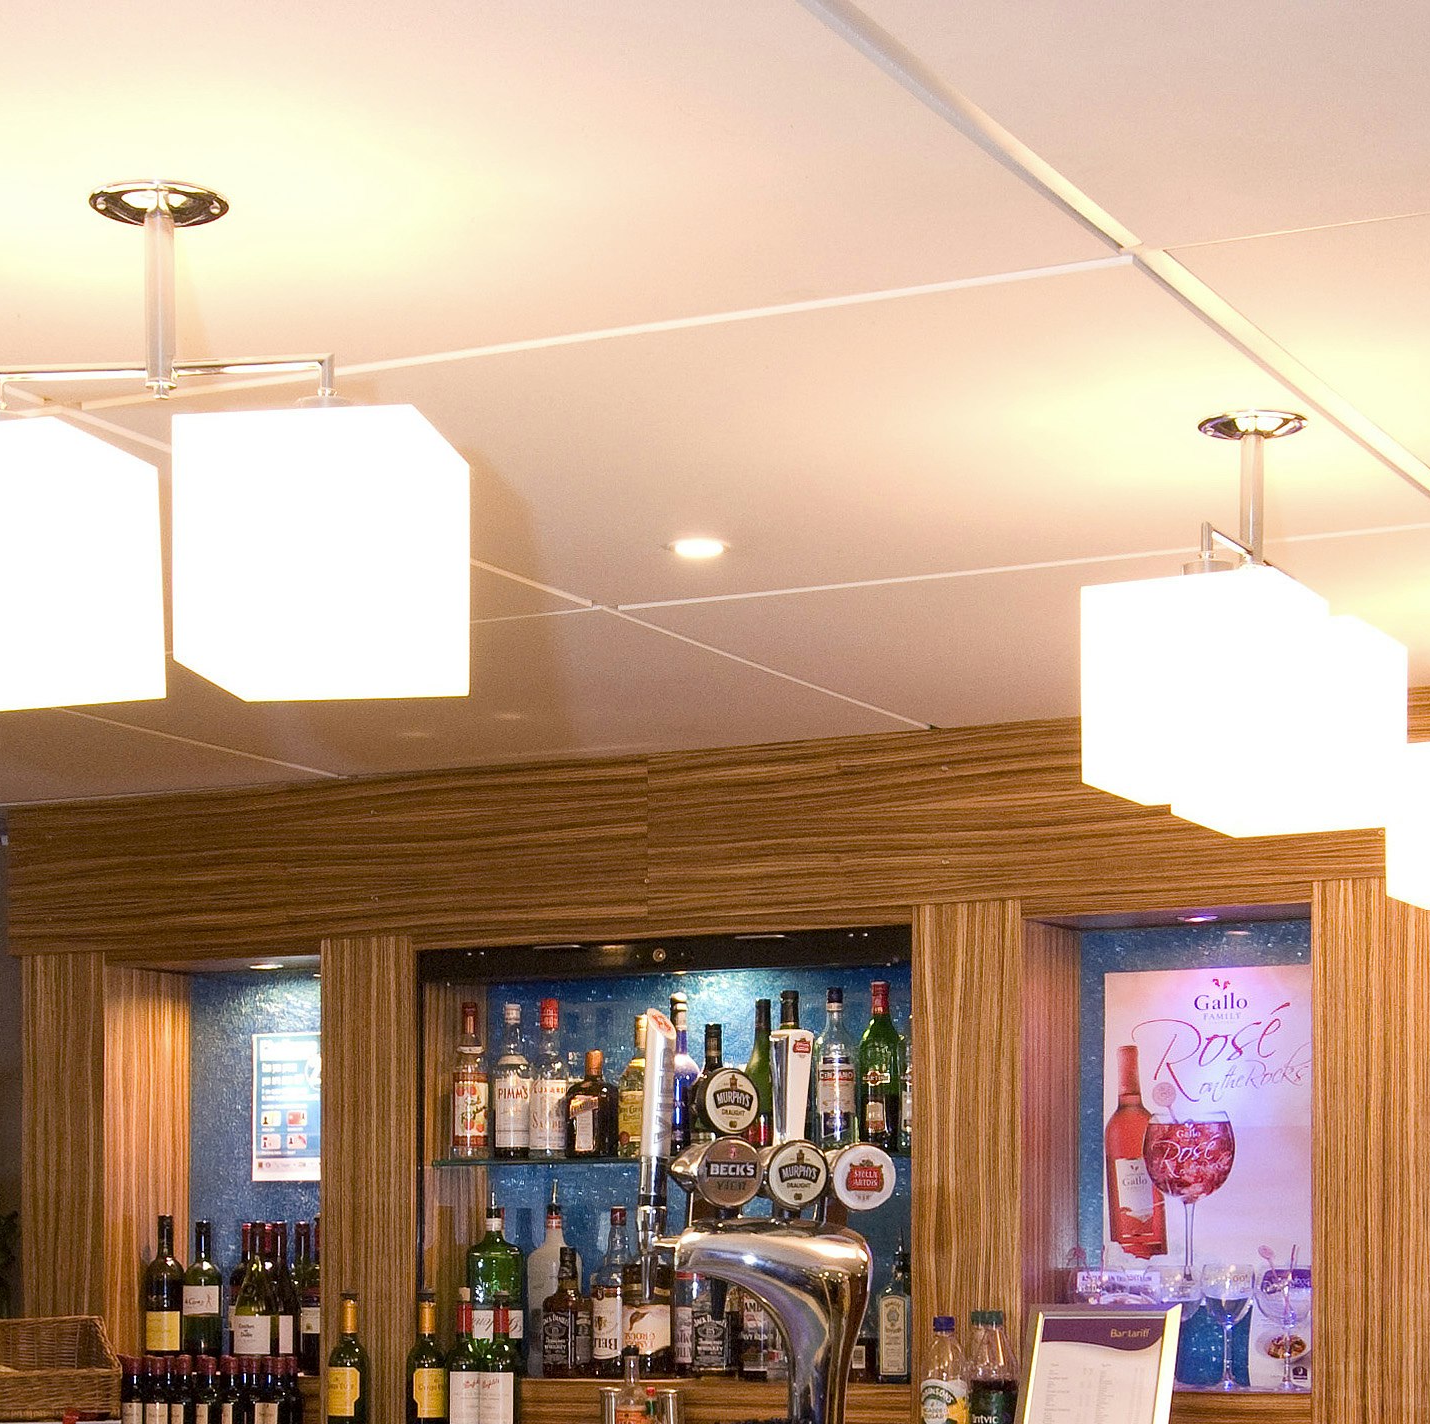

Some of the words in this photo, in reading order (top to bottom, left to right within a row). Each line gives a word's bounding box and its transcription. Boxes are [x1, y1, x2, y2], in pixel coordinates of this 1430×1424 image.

[1193, 992, 1248, 1011] Gallo
[1131, 1002, 1291, 1103] Rosé
[498, 1085, 529, 1099] PIMM'S
[1176, 1128, 1202, 1138] Gallo
[709, 1162, 755, 1177] BECK'S
[854, 1170, 878, 1179] STELLA
[716, 1180, 747, 1191] VIER
[852, 1179, 878, 1187] ARTOIS
[1122, 1175, 1148, 1187] Gallo
[1110, 1328, 1126, 1338] Bar
[1127, 1327, 1151, 1338] tariff
[972, 1413, 999, 1424] ritvic
